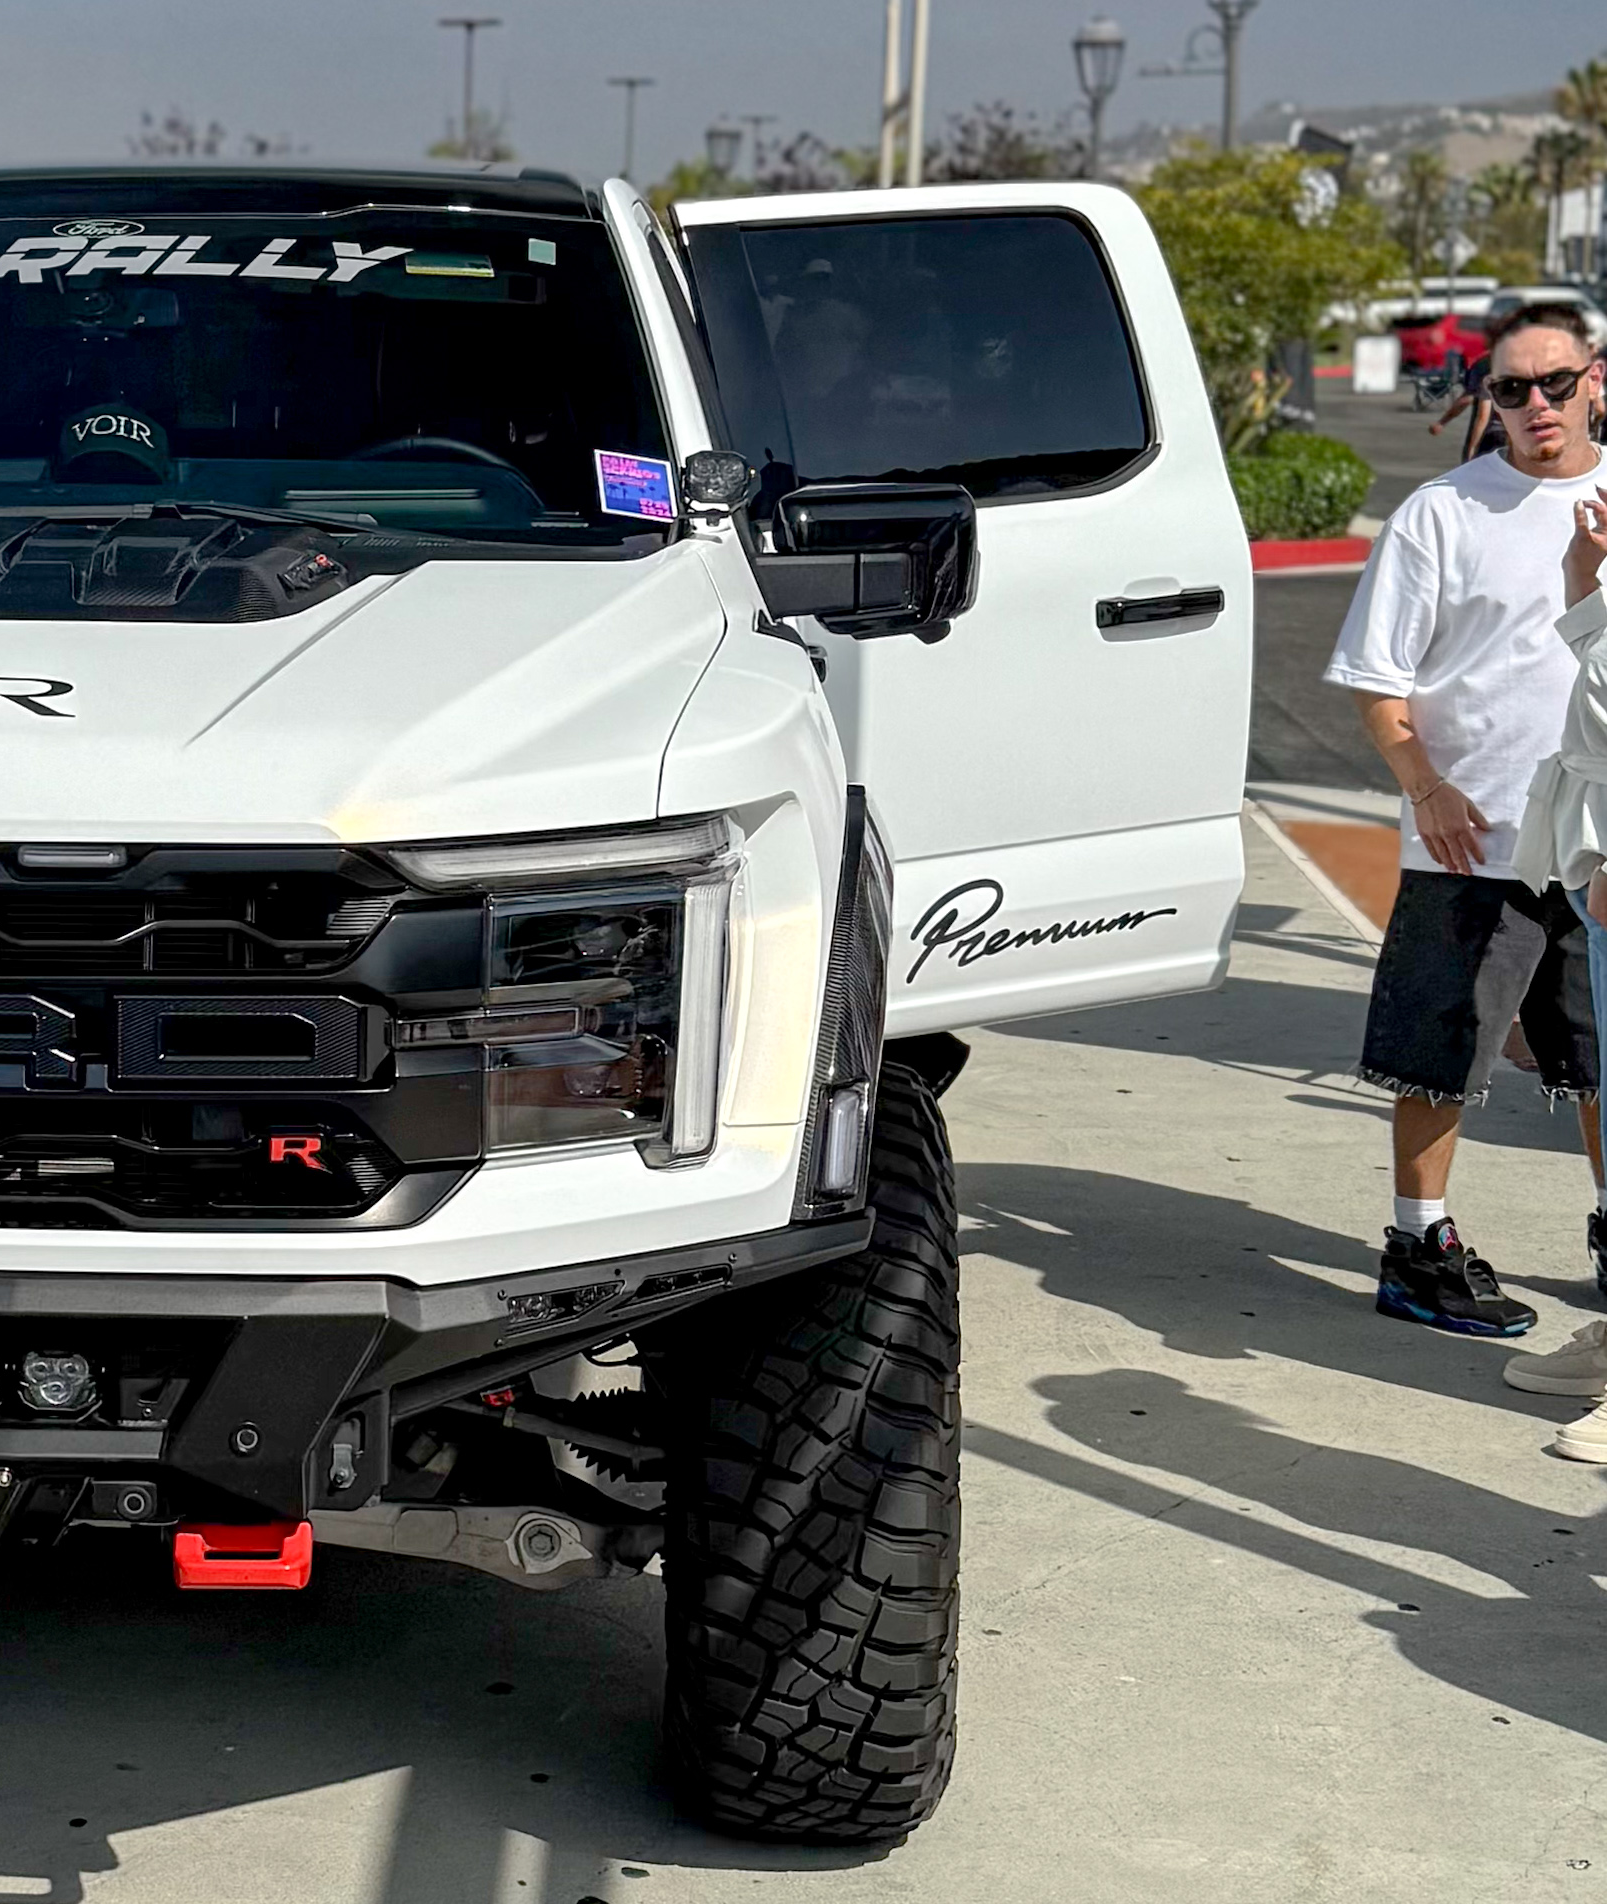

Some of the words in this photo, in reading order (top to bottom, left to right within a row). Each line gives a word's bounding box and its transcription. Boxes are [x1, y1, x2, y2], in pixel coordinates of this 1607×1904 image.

[64, 220, 132, 236] Ford
[71, 414, 155, 448] VOIR
[905, 878, 1178, 985] Premium
[269, 1136, 327, 1170] R
